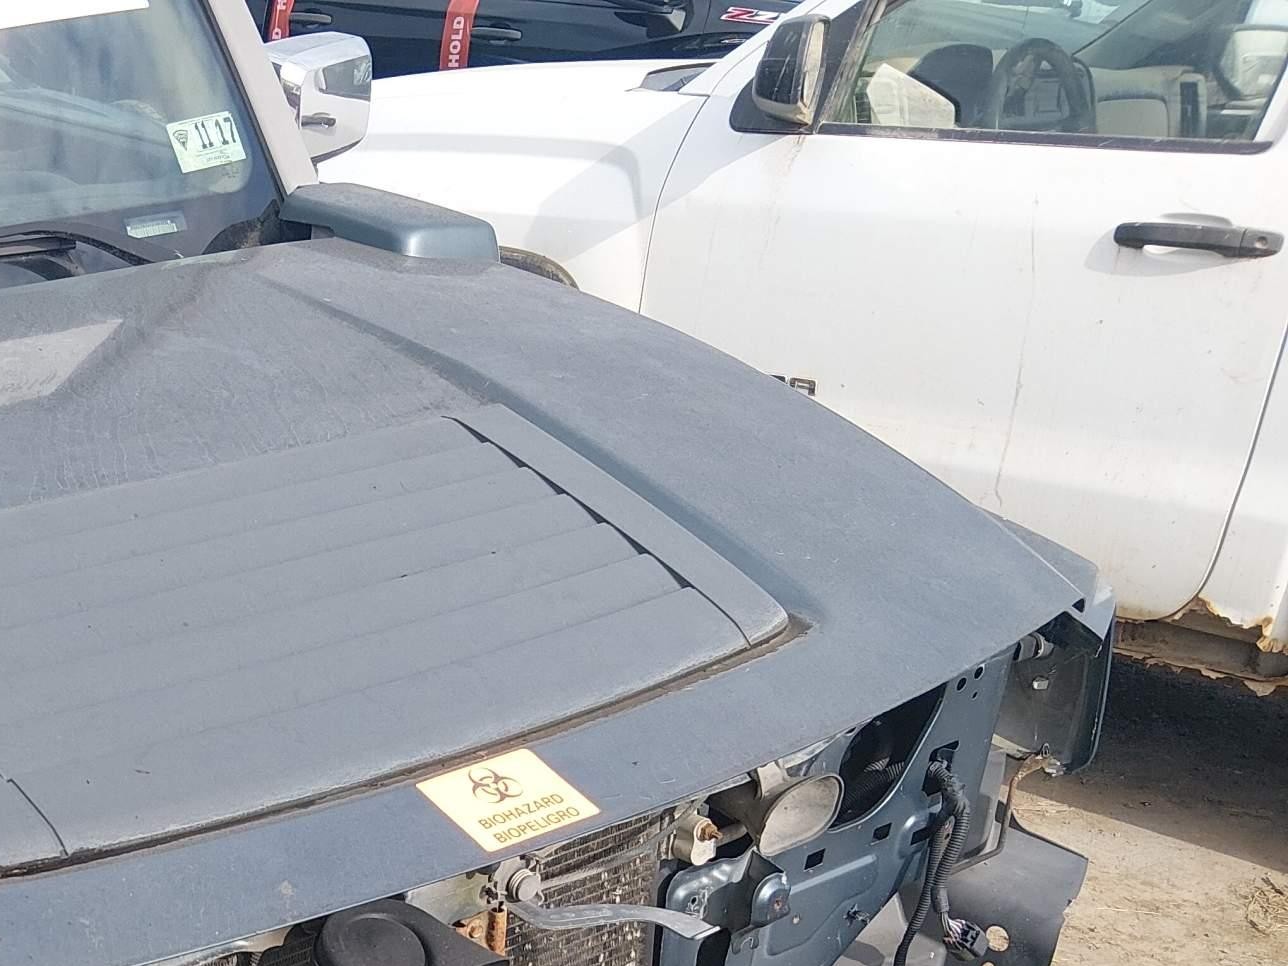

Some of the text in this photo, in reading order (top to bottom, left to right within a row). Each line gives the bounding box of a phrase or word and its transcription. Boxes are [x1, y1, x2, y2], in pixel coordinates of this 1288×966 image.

[448, 16, 464, 68] HOLD
[194, 120, 214, 149] 11
[214, 117, 237, 145] 17
[478, 793, 565, 830] BIOHAZARD
[493, 806, 581, 844] BIOPELIGRO
